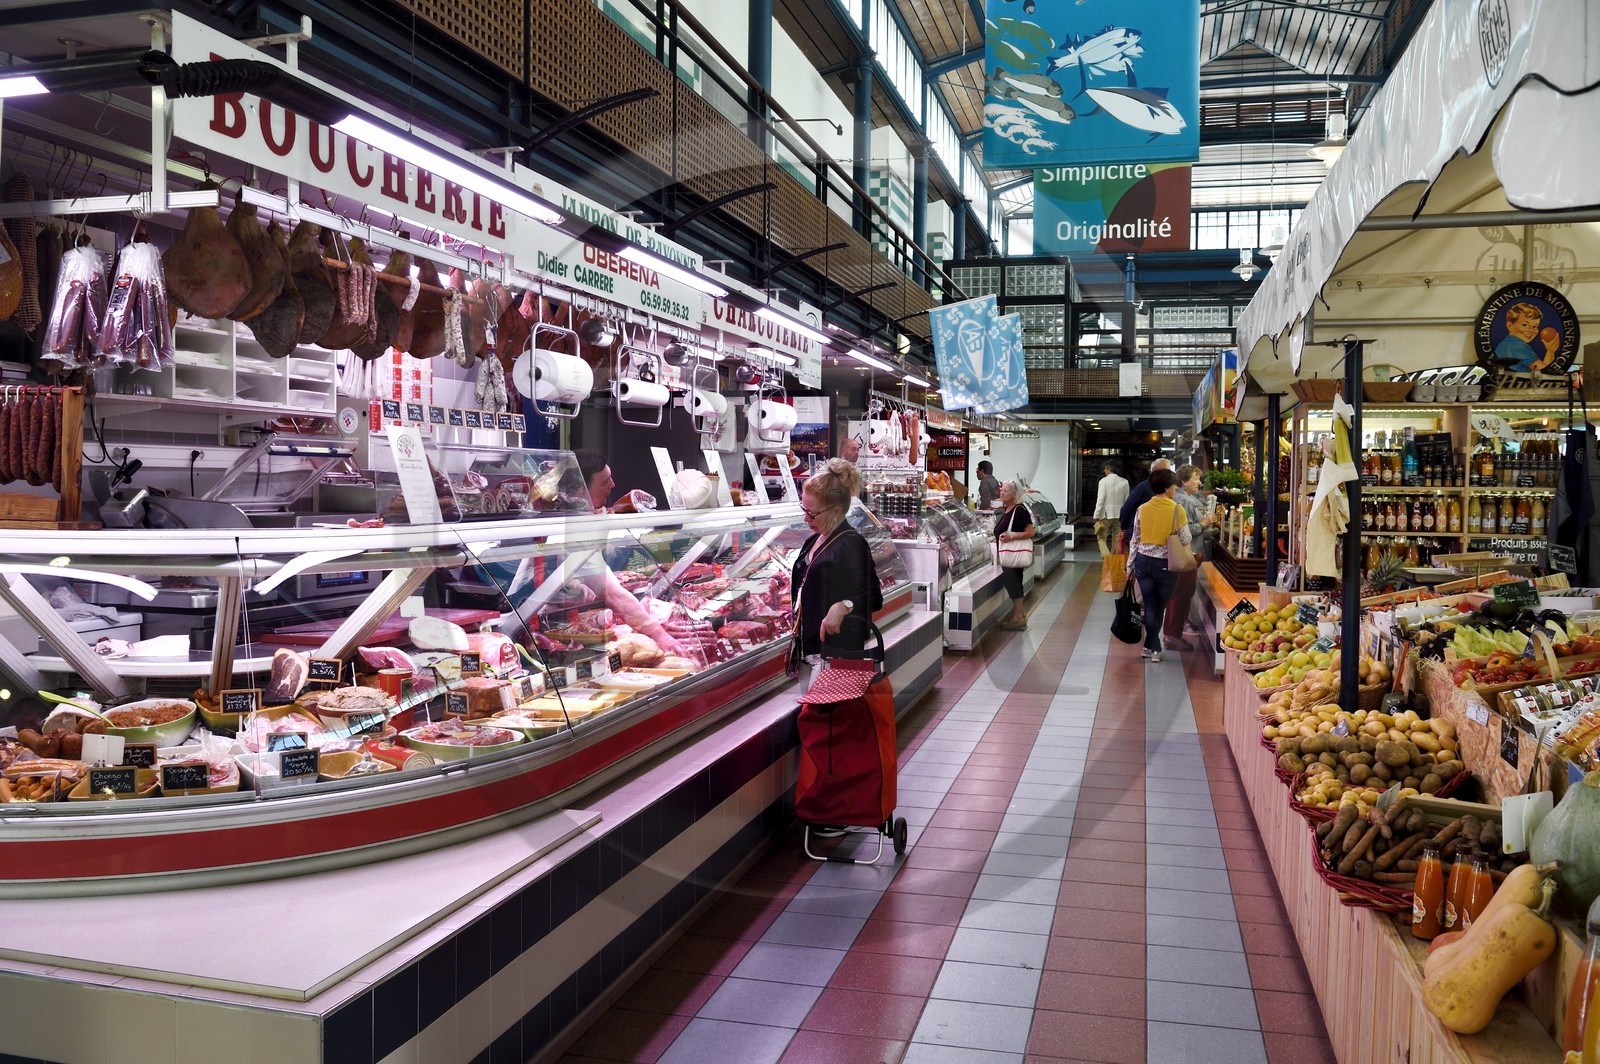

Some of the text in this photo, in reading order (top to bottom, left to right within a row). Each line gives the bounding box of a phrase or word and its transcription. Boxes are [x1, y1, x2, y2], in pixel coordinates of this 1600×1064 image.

[1056, 216, 1172, 245] Originalité
[537, 250, 614, 294] Didier CARRERE
[583, 243, 660, 289] OBERENA
[640, 289, 690, 321] 05.59.59.35.32
[1478, 287, 1576, 371] CLÉMENTINE DE MON ENFANCE
[1491, 537, 1528, 549] Produits
[92, 771, 121, 780] Chorizo
